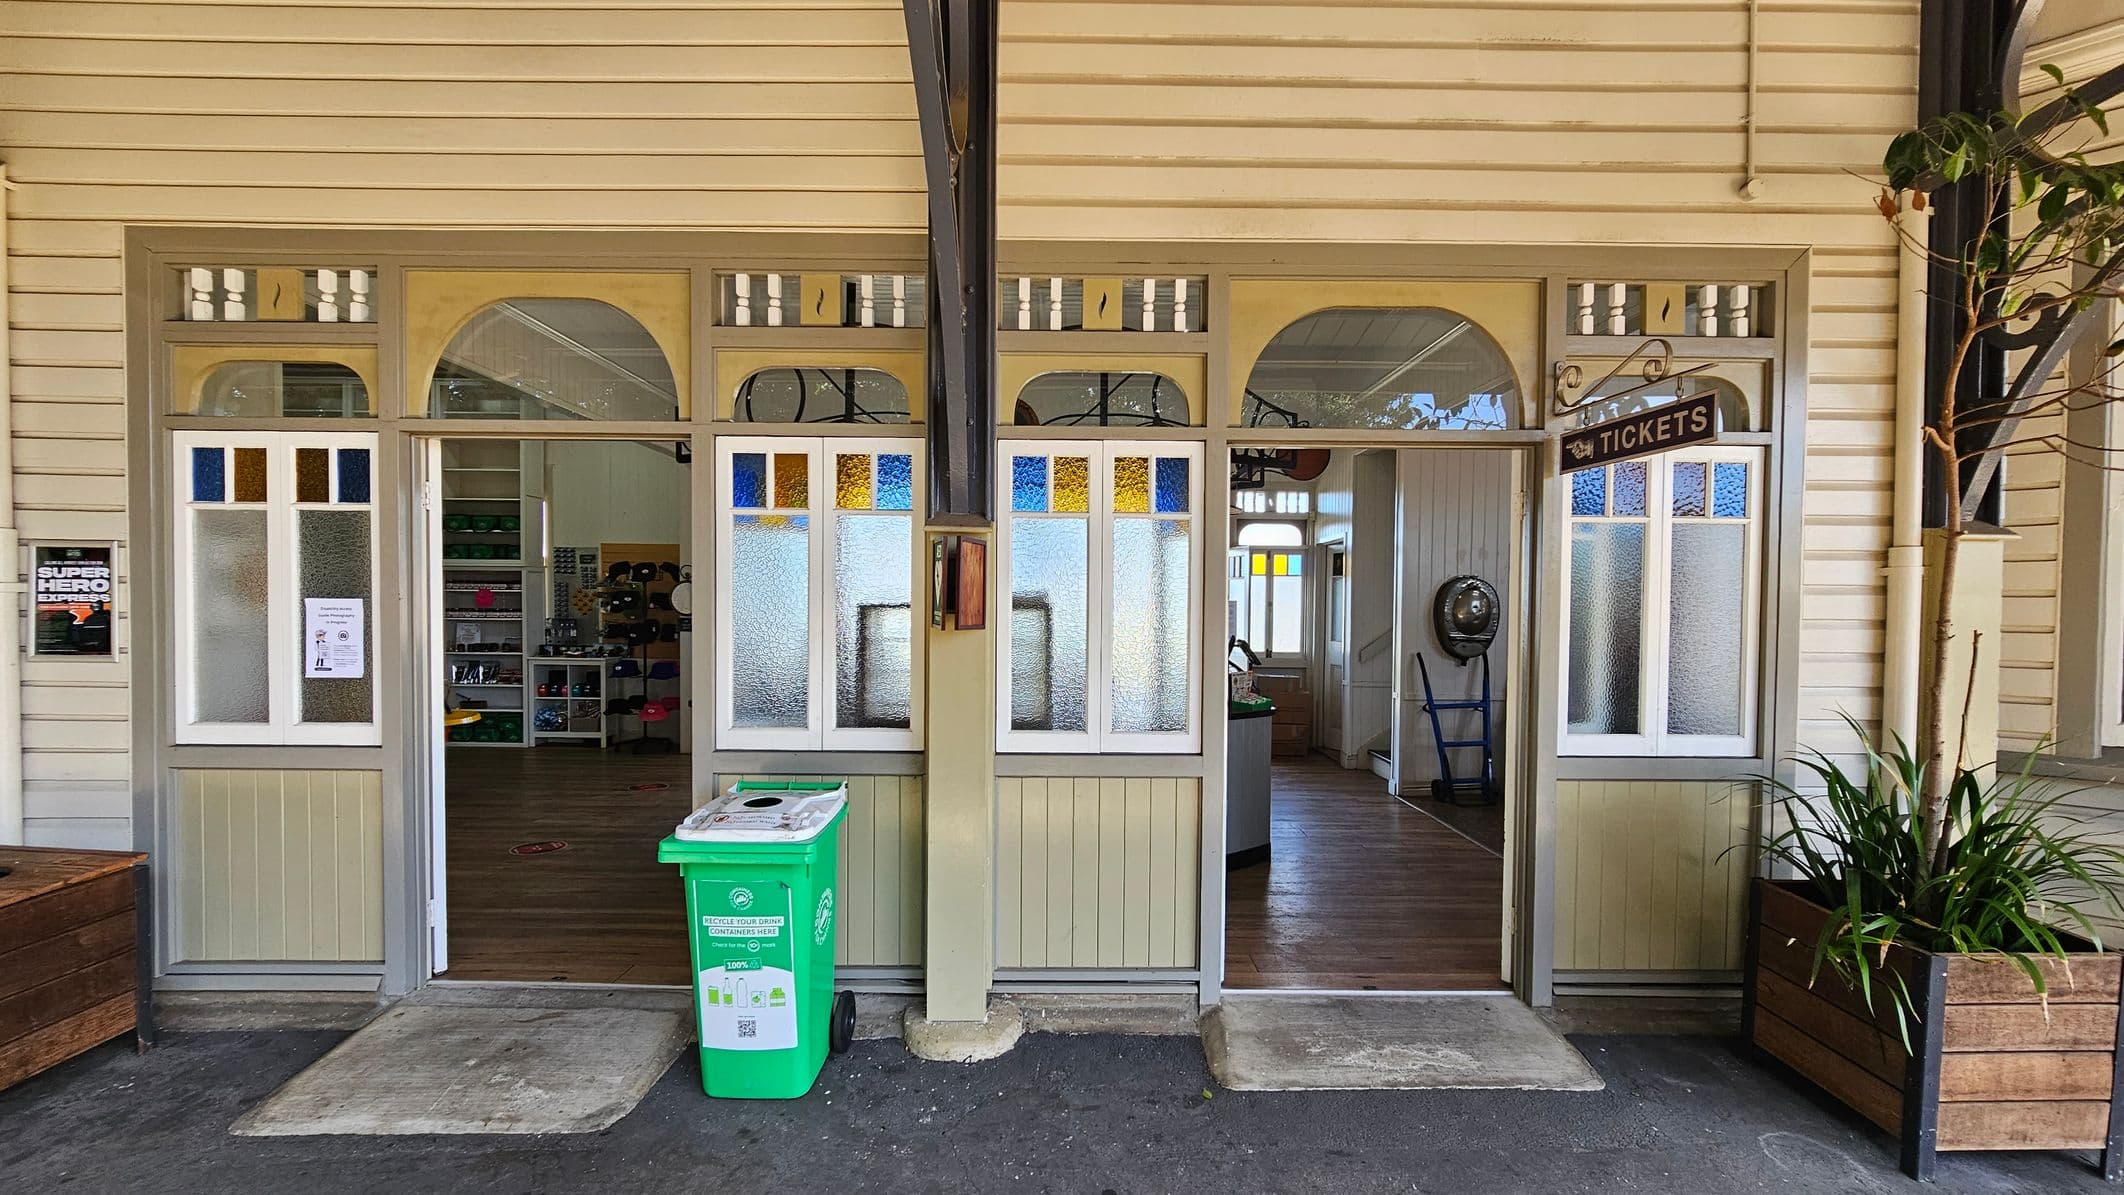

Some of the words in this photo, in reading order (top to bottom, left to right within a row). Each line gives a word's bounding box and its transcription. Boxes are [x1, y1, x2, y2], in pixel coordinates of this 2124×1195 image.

[1600, 405, 1708, 454] TICKETS
[37, 567, 110, 578] SUPER
[37, 578, 110, 592] HERO
[37, 593, 111, 602] EXPRESS
[704, 917, 734, 925] RECYCLE
[726, 961, 749, 969] 100%
